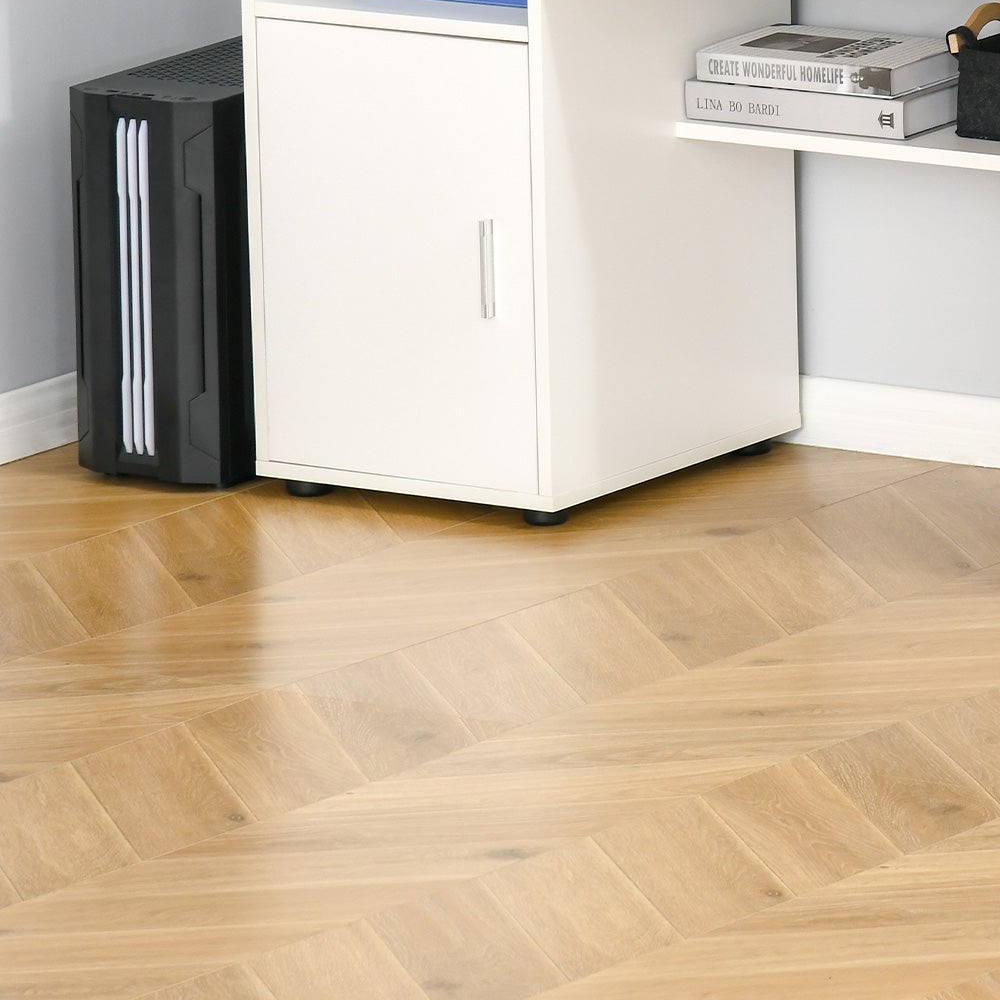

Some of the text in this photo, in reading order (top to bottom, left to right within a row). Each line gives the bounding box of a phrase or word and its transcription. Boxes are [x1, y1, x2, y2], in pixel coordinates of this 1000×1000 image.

[708, 58, 844, 85] CREATE WONDERFUL HOMELIFE
[696, 97, 781, 117] LINA BO BARDI
